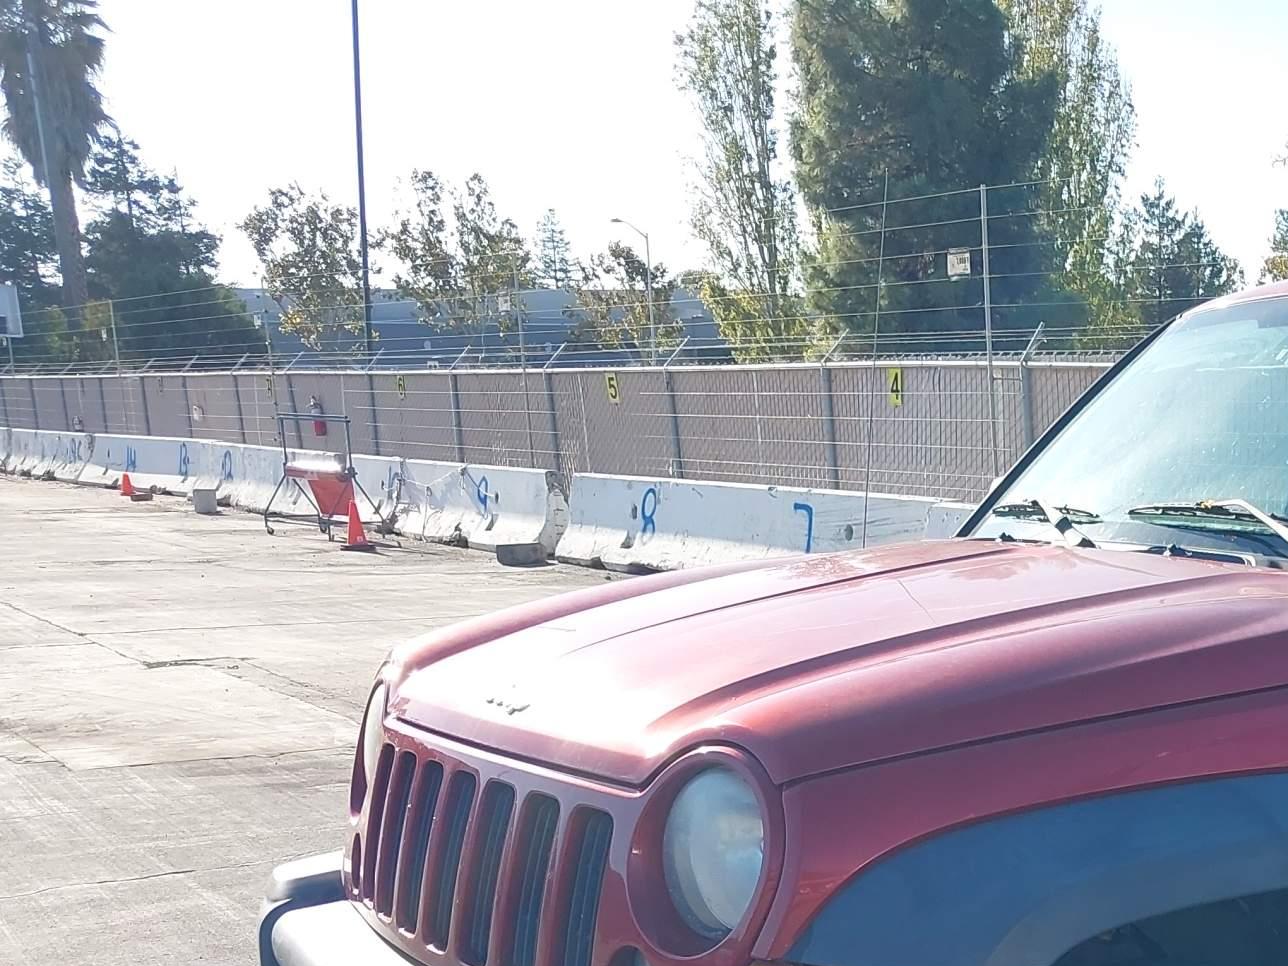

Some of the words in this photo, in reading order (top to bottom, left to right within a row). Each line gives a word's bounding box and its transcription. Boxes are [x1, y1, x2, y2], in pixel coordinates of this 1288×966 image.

[607, 376, 618, 401] 5
[891, 371, 900, 400] 4
[641, 488, 657, 544] 8
[793, 502, 815, 554] 7
